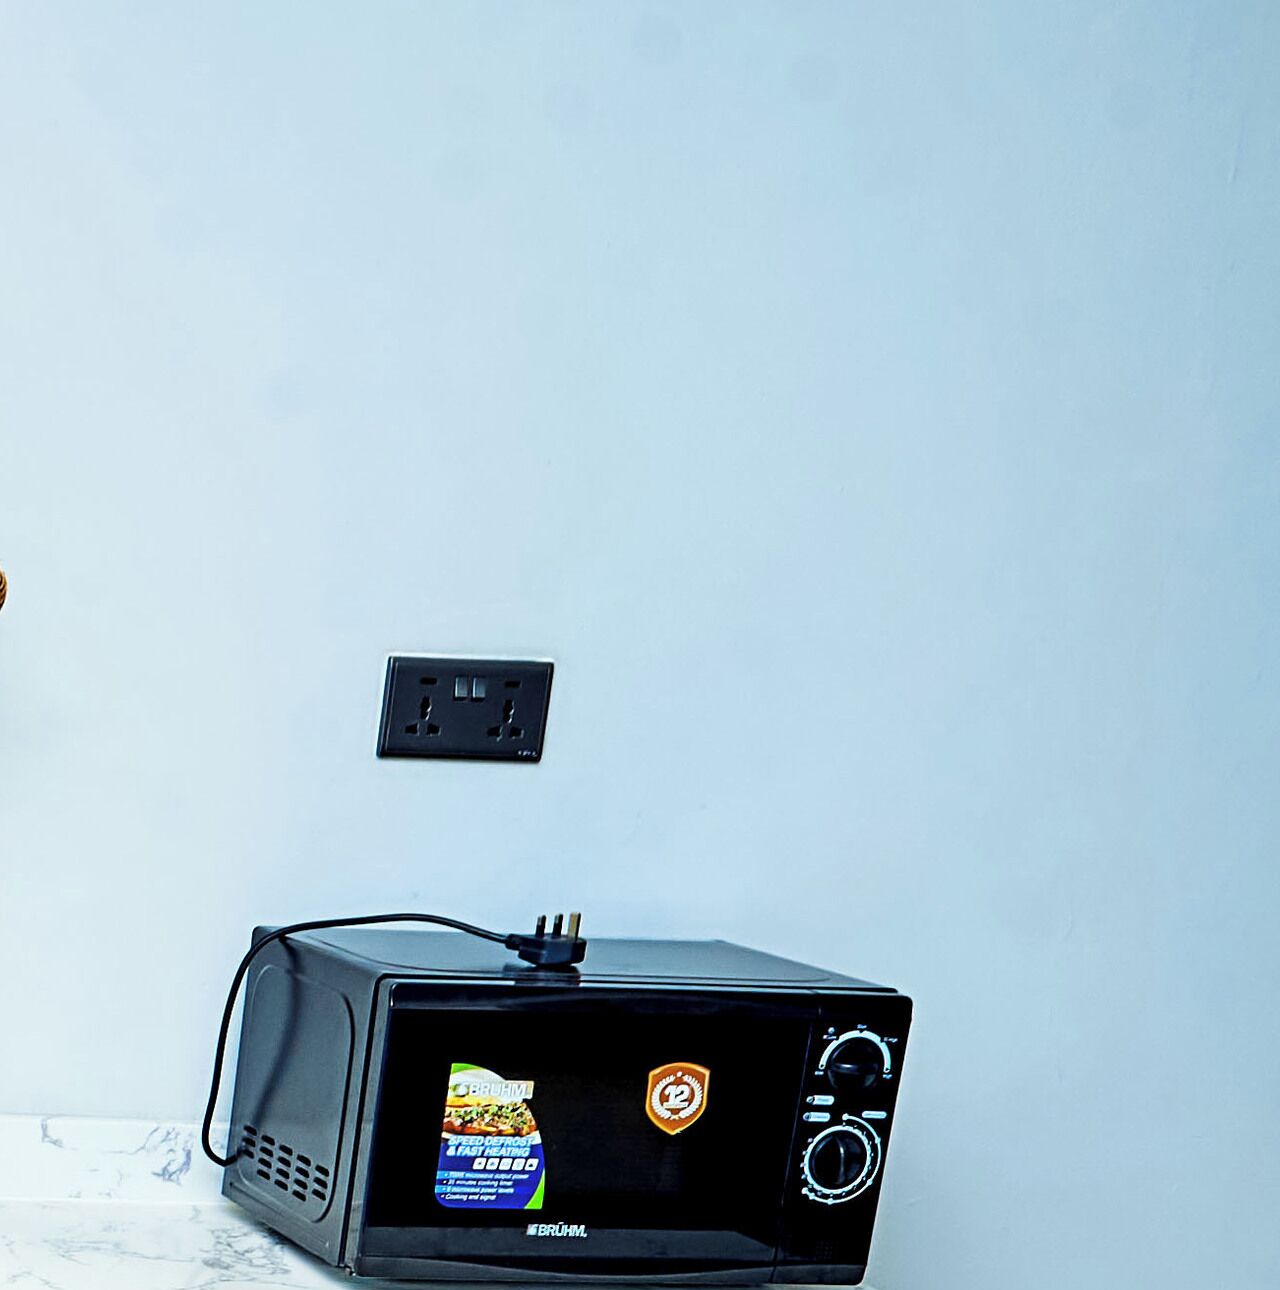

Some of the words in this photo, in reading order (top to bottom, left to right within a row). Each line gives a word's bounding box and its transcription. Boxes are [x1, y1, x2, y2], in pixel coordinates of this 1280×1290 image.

[664, 1084, 690, 1105] 12
[448, 1135, 485, 1147] SPEED
[484, 1136, 535, 1147] DEFROST
[446, 1145, 456, 1157] &
[456, 1146, 485, 1157] FAST
[483, 1146, 532, 1158] HEATING
